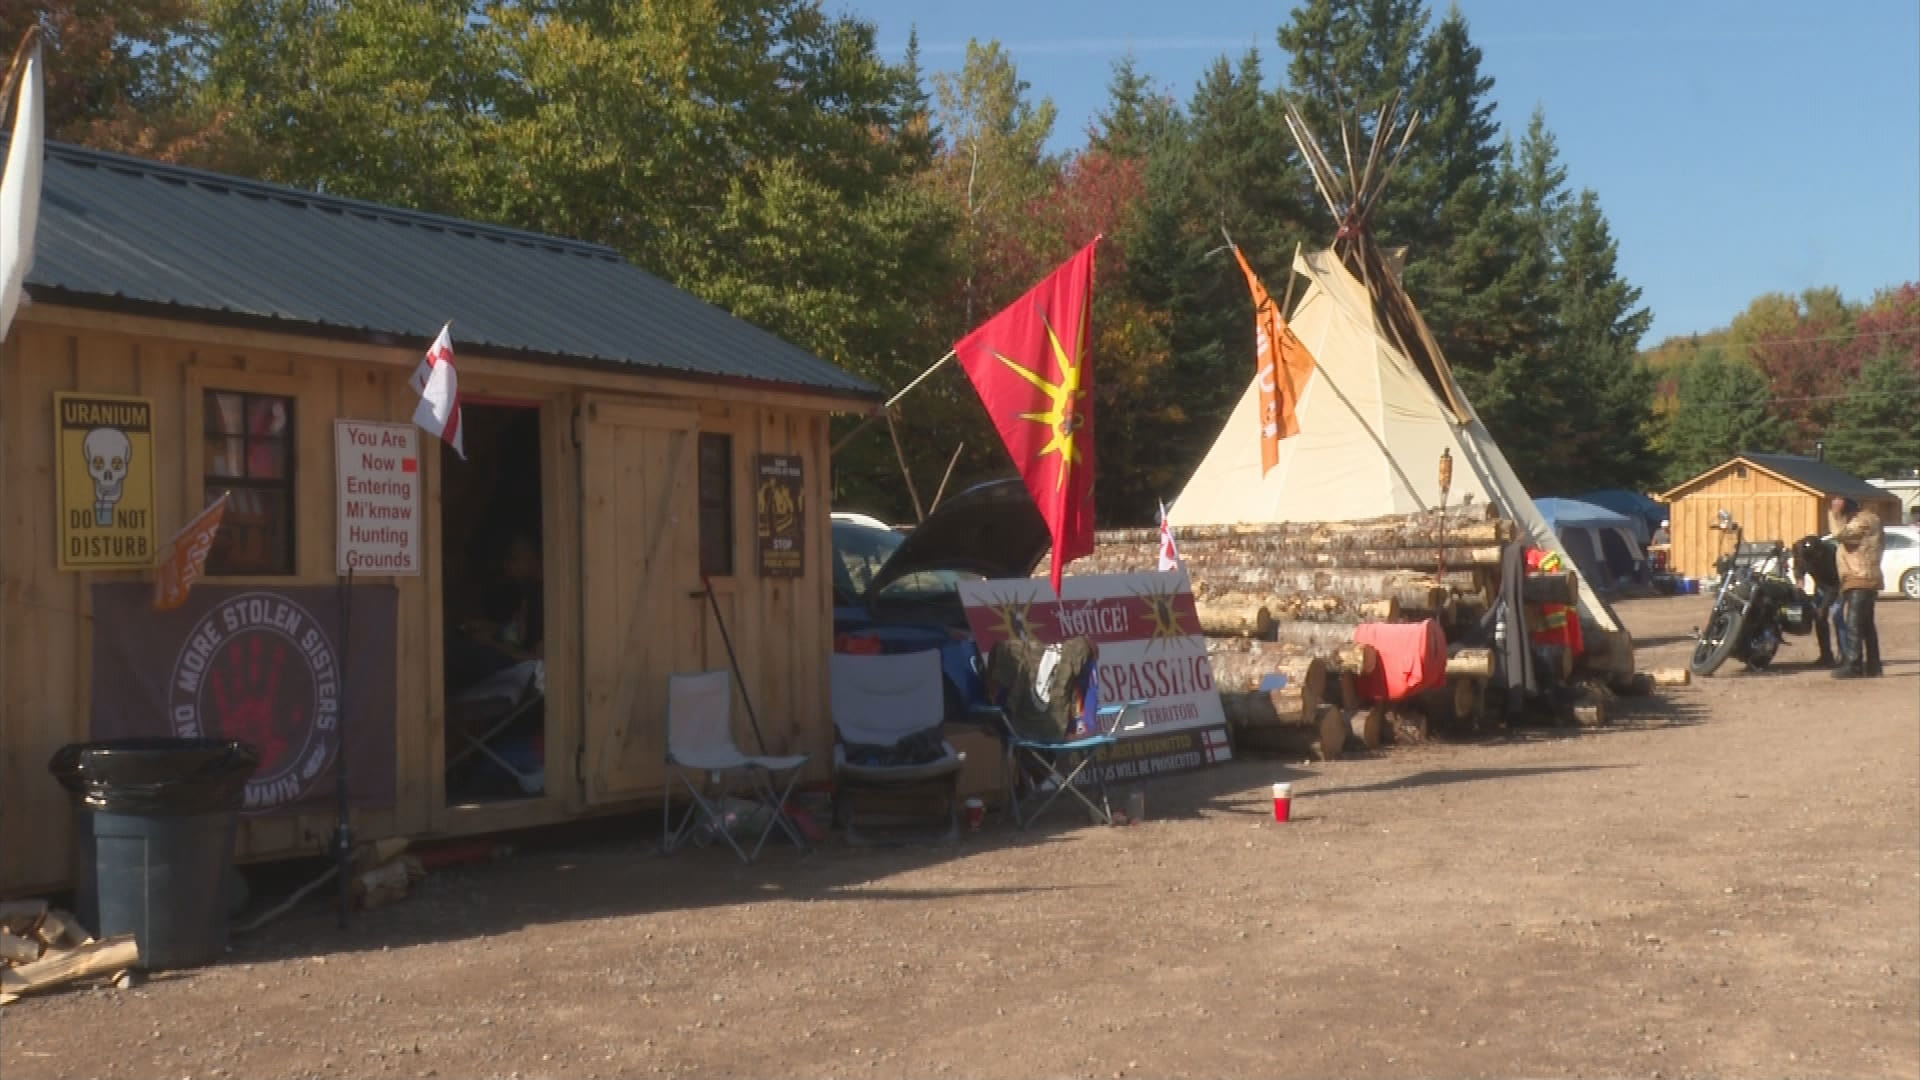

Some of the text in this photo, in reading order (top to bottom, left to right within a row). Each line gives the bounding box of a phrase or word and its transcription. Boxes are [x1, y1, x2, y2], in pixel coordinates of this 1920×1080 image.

[64, 403, 147, 425] URANIUM
[348, 428, 407, 449] You Are
[362, 453, 395, 471] Now
[347, 476, 411, 500] Entering
[71, 509, 147, 529] DO NOT
[347, 501, 412, 520] Mi'kmaw
[71, 536, 147, 557] DISTURB
[350, 525, 409, 548] Hunting
[346, 549, 411, 568] Grounds
[1058, 606, 1129, 636] NOTICE!
[175, 599, 338, 738] NO MORE STOLEN SISTERS
[1100, 655, 1211, 702] SPASSING
[1142, 704, 1199, 725] TERRITORY
[1116, 760, 1138, 777] WILL
[1151, 752, 1201, 773] PROSECUTED
